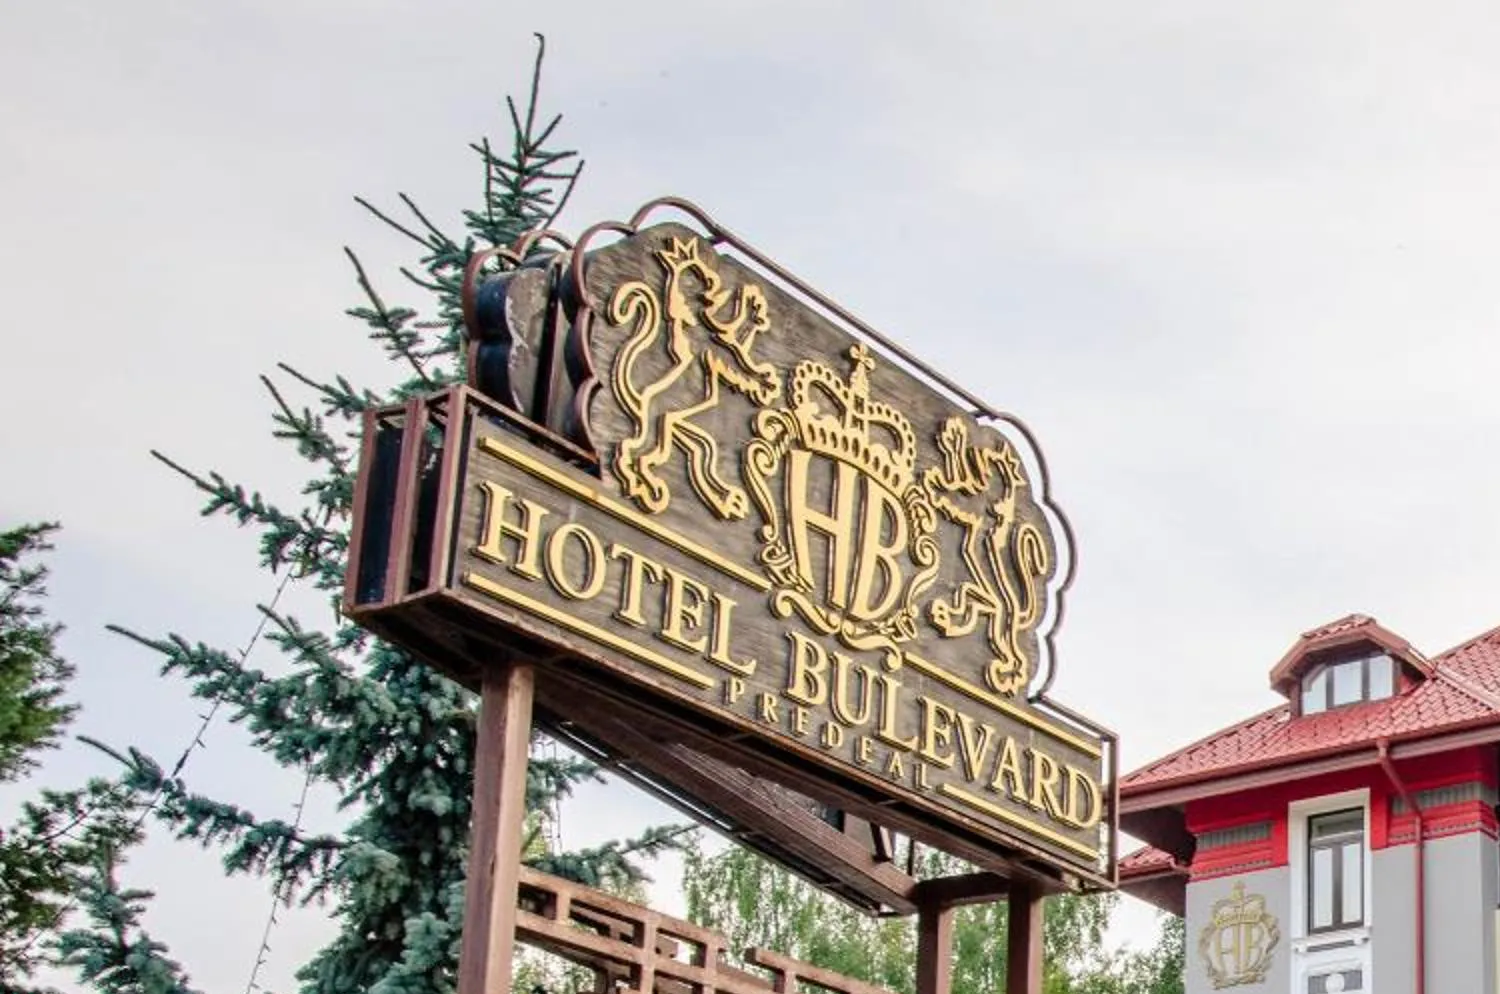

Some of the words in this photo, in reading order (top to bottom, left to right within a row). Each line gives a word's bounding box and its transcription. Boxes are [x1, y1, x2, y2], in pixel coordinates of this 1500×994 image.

[471, 480, 757, 677] HOTEL
[783, 630, 1102, 830] BULEVARD
[723, 675, 934, 791] PREDEAL
